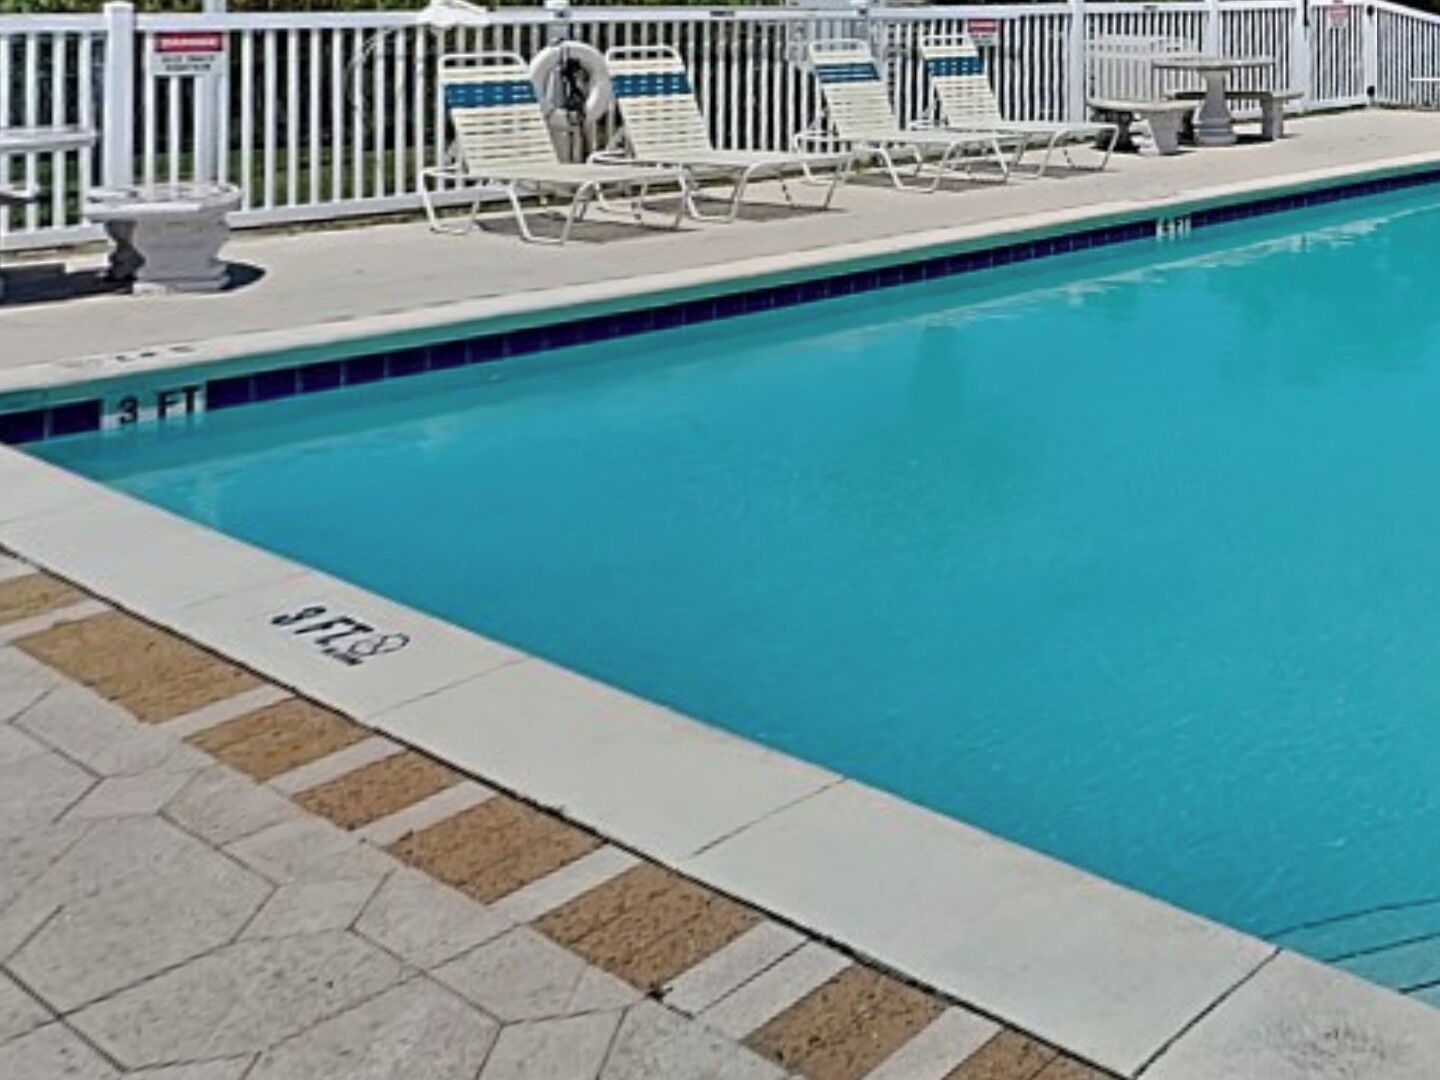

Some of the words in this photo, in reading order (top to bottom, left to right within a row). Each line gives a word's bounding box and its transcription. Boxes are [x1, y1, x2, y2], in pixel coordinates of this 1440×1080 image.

[118, 395, 139, 424] 3
[157, 383, 201, 419] FT
[293, 616, 374, 645] FT
